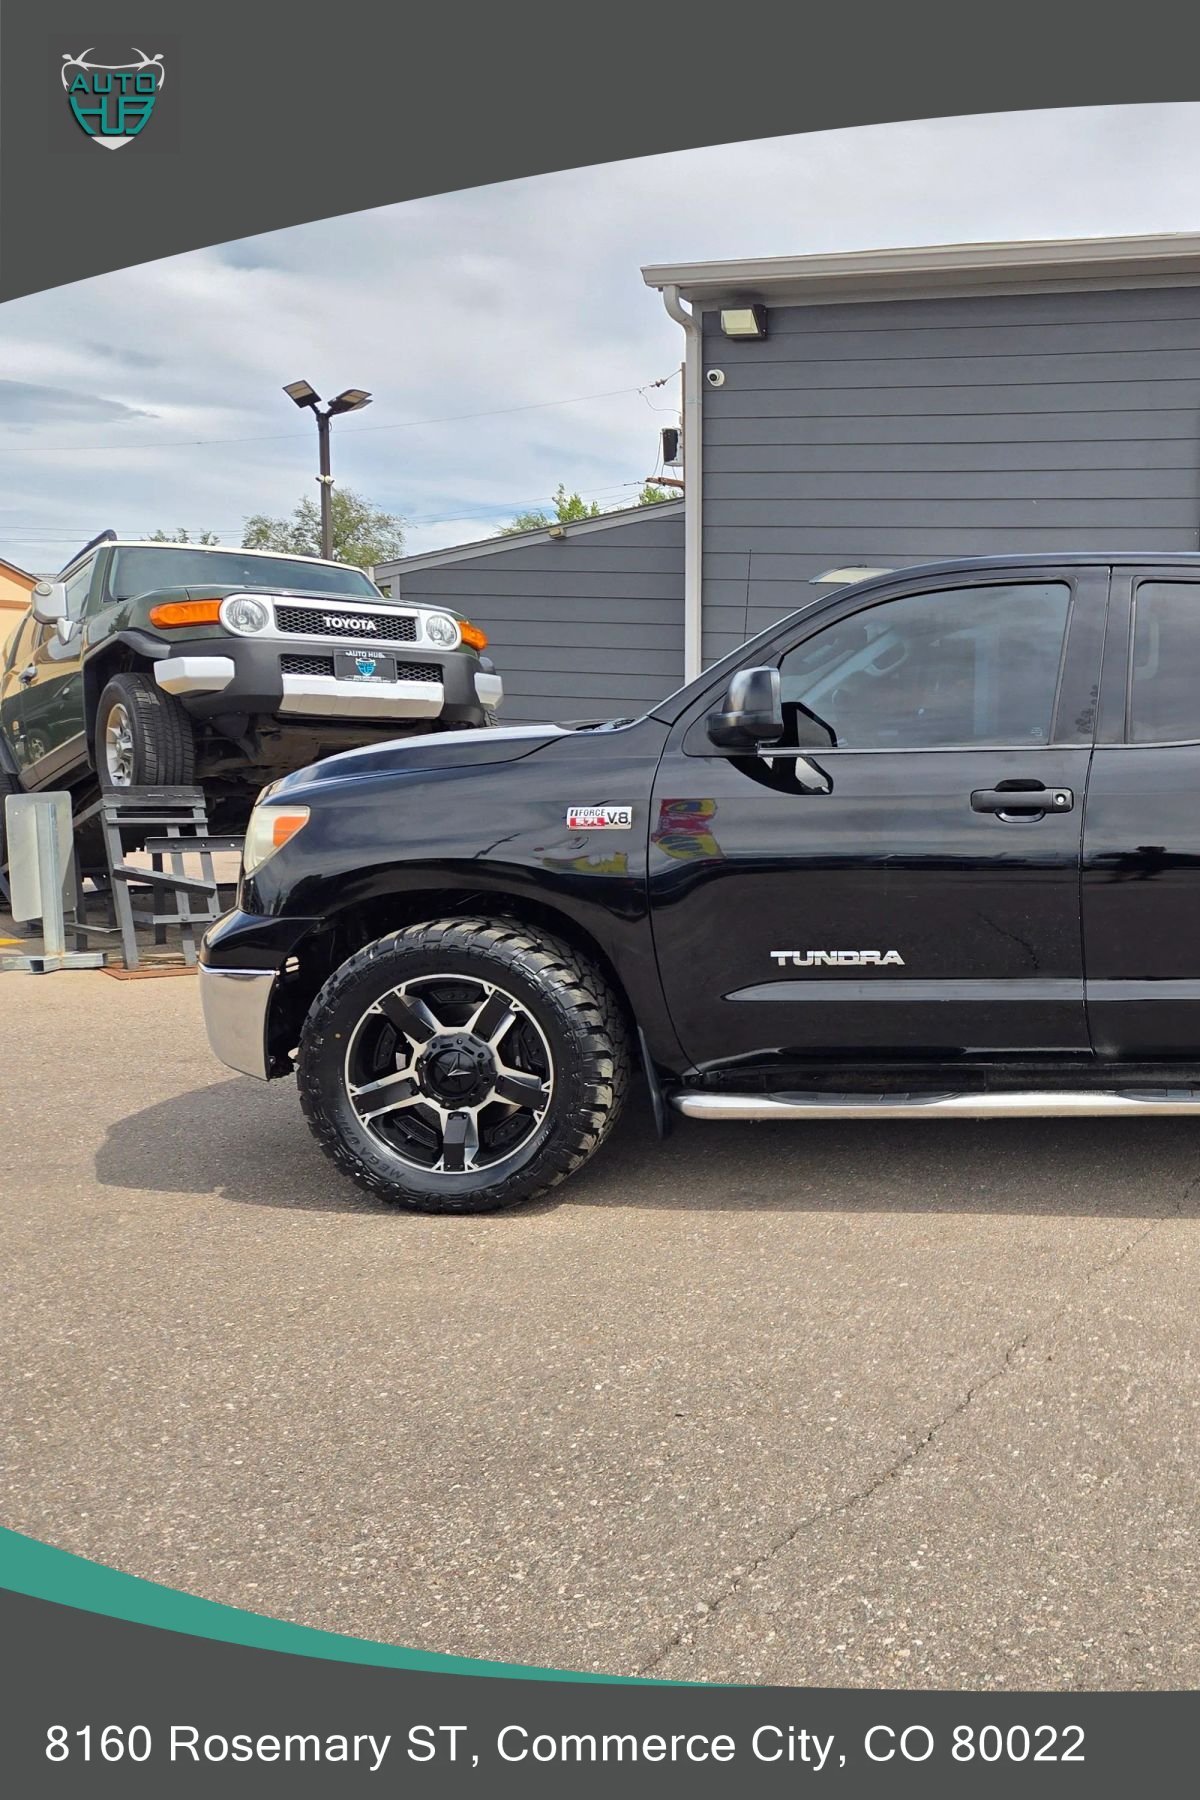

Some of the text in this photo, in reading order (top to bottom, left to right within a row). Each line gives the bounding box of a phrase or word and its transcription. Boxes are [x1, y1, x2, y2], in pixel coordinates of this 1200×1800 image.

[323, 616, 377, 631] TOYOTA
[347, 650, 366, 658] AUTO
[770, 950, 906, 966] TUNDRA
